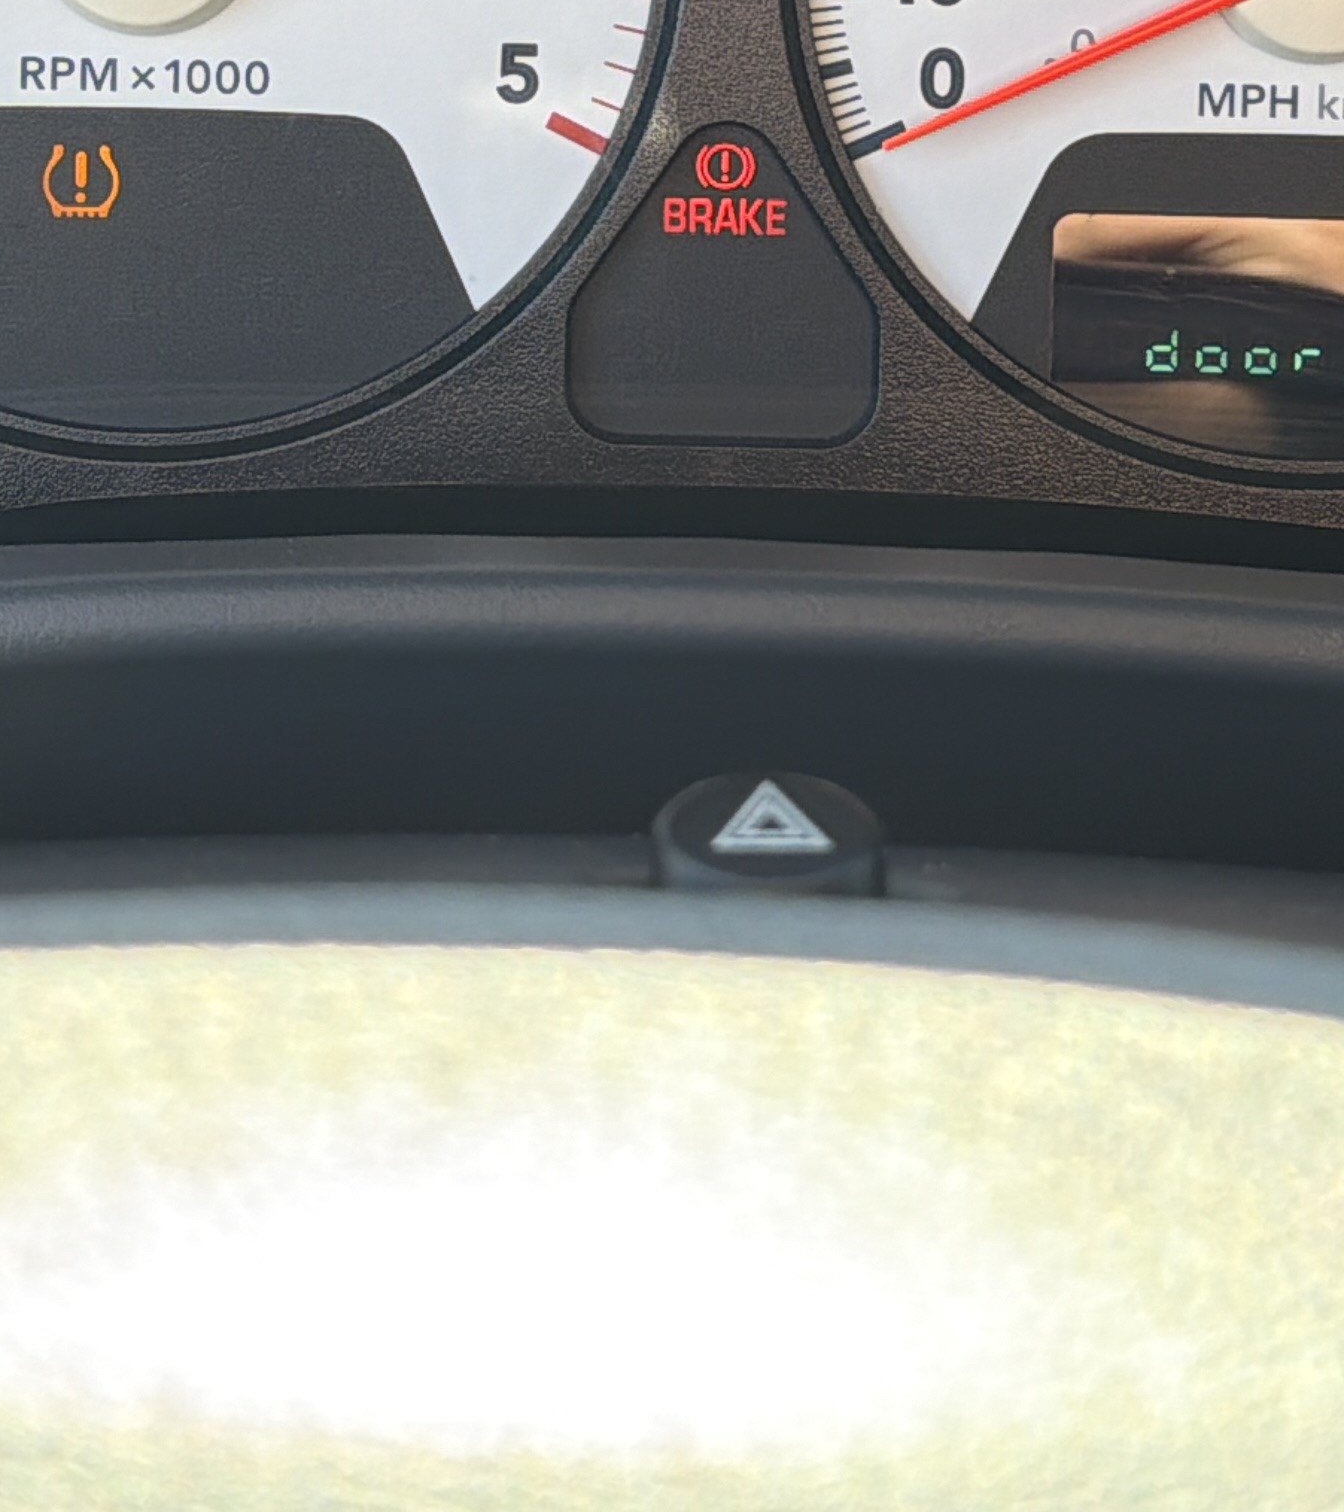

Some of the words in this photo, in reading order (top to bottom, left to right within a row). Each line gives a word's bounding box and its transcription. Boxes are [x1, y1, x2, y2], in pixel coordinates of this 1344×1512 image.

[20, 55, 118, 91] RPM
[496, 43, 539, 104] 5
[920, 47, 965, 110] 0
[1198, 83, 1298, 119] MPH
[662, 198, 787, 236] BRAKE
[1145, 331, 1321, 375] door
